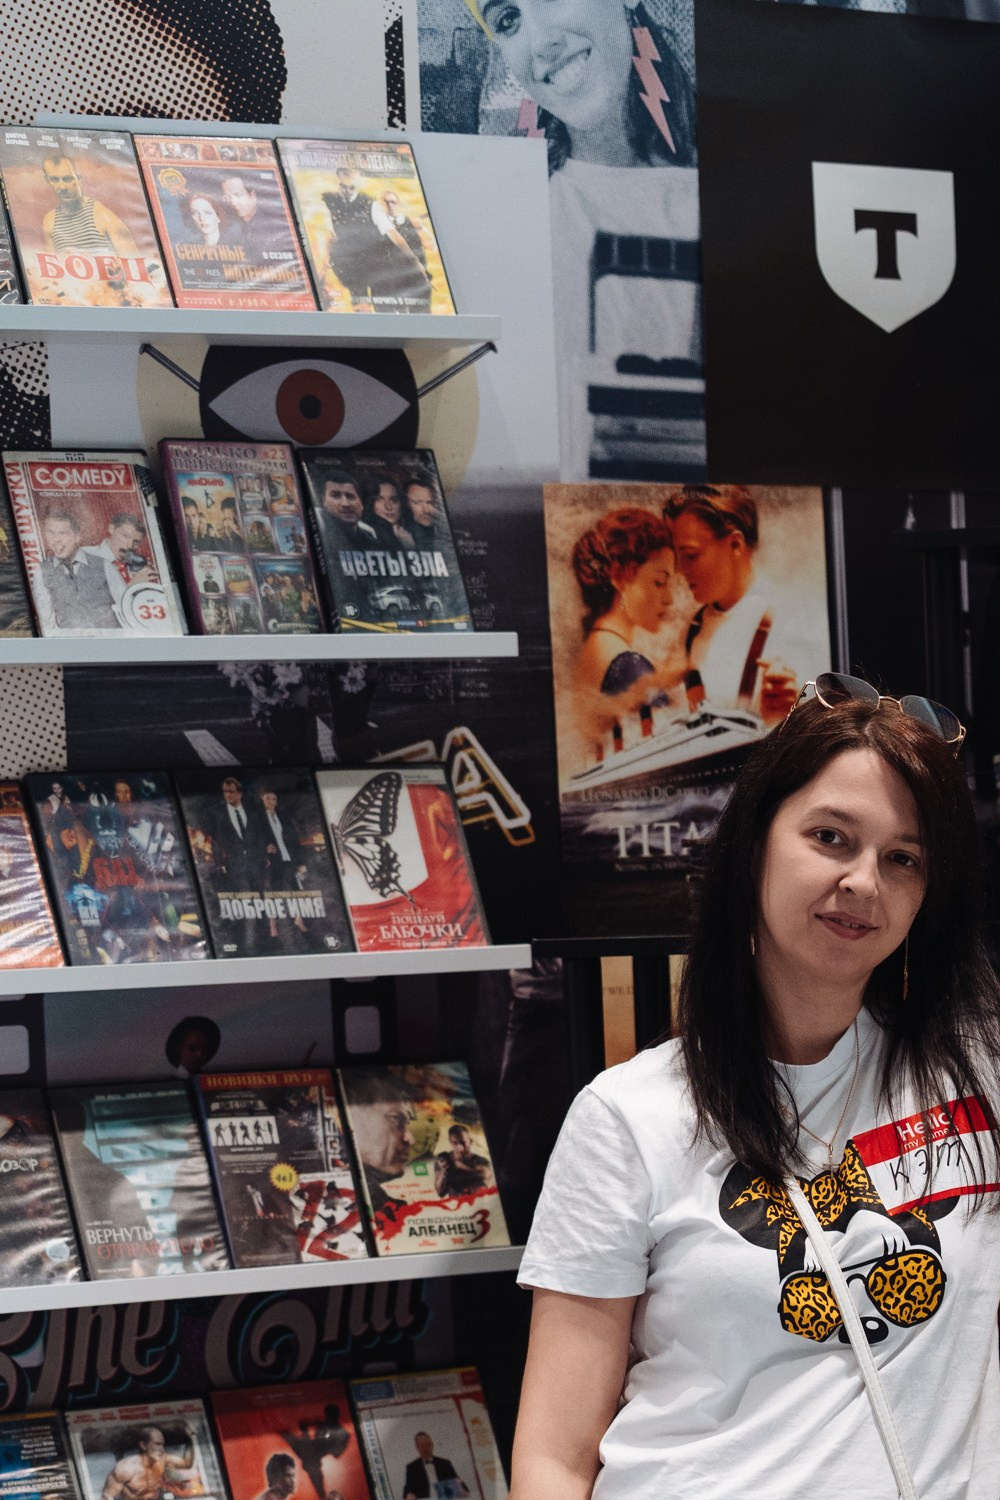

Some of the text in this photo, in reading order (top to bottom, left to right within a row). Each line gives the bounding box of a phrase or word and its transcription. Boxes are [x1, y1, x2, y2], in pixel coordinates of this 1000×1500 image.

[176, 243, 248, 263] СЕКРЕТНЫЕ
[270, 252, 294, 261] СЕЗОН
[36, 252, 156, 289] БОЕЦ
[184, 268, 221, 277] THE FILES
[172, 446, 257, 459] ТОЛЬКО
[172, 458, 289, 472] ПРИКЛЮЧЕНИЯ
[35, 466, 128, 487] COMEDY
[5, 461, 34, 535] ШУТКИ
[339, 550, 450, 581] ЦВЕТЫ ЗЛА
[138, 604, 167, 621] 33
[612, 820, 704, 859] TITA
[219, 896, 327, 920] ДОБРОЕ ИМЯ
[391, 911, 446, 925] ПОЦЕЛУЙ
[379, 922, 464, 941] БАБОЧКИ
[206, 1073, 313, 1087] НОВИНКИ DVD
[903, 1138, 920, 1151] my
[407, 1215, 474, 1225] ПСЕВДОНИМ
[408, 1208, 492, 1244] АЛБАНЕЦ 3
[86, 1225, 154, 1246] ВЕРНУТЬ
